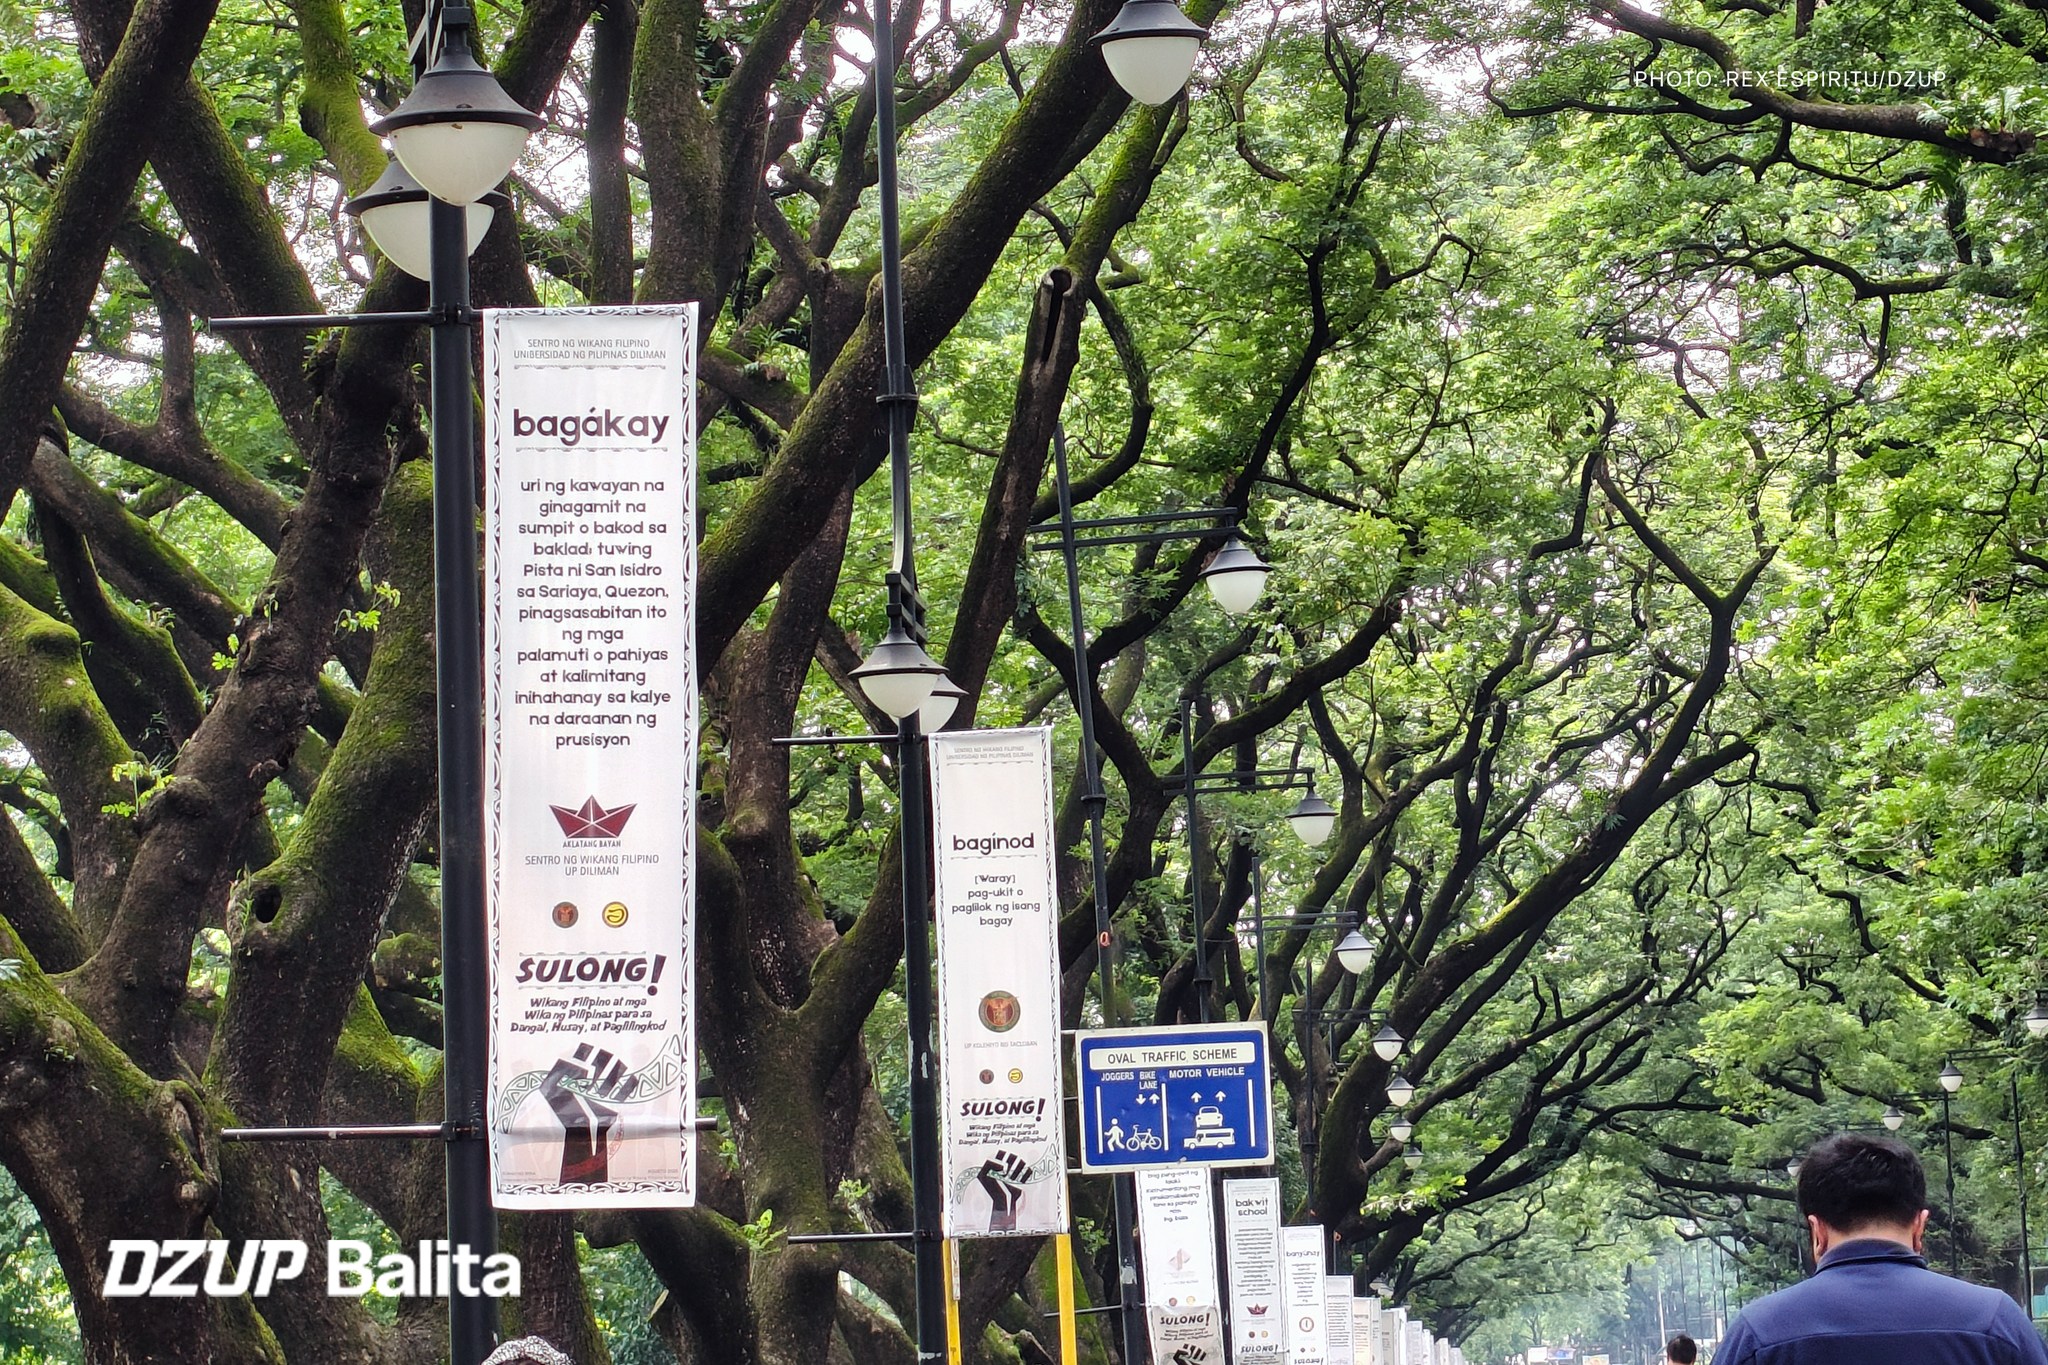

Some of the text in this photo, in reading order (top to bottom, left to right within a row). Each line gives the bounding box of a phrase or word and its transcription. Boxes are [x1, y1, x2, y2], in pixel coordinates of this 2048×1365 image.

[527, 339, 650, 348] SENTRO NG WIKANG FILIPINO
[513, 350, 666, 359] UNIBERSIDAD NG PILIPINAS DILIMAN
[513, 407, 670, 446] bagákay
[521, 479, 664, 496] uri ng kawayan na
[539, 501, 646, 517] ginagamit na
[518, 521, 667, 537] sumpit o bakod sa
[597, 542, 652, 558] tuwing
[523, 563, 662, 577] Pista ni San Isidro
[517, 585, 669, 601] sa Sariaya, Quezon,
[519, 606, 667, 622] pinagsasabitan ito
[562, 629, 624, 643] ng mga
[517, 648, 668, 664] palamuti o pahiyas
[540, 669, 646, 685] at kalimitang
[515, 689, 671, 706] inihahanay sa kalye
[529, 712, 656, 727] na daraanan ng
[556, 733, 630, 749] prusisyon
[563, 840, 621, 848] AKLATANG BAYAN
[525, 855, 659, 865] SENTRO NG WIKANG FILIPINO
[565, 866, 619, 876] UP DILIMAN
[968, 887, 1014, 900] pag-ukit
[951, 902, 1041, 914] paglilok ng isang
[979, 916, 1013, 927] bagay
[515, 954, 667, 996] SULONG!
[530, 997, 647, 1008] Wikang Filipino at mga
[524, 1010, 652, 1022] Wika ng Pilipinas para sa
[510, 1020, 667, 1034] Dangal, Husay, at Paglilingkod
[1107, 1048, 1237, 1064] OVAL TRAFFIC SCHEME
[1101, 1071, 1134, 1081] JOGGERS
[1139, 1071, 1156, 1080] BIKE
[1169, 1067, 1245, 1078] MOTOR VEHICLE
[1139, 1081, 1158, 1090] LANE
[960, 1098, 1046, 1122] SULONG!
[1238, 1207, 1268, 1216] school
[1160, 1313, 1210, 1326] SULONG!
[1240, 1344, 1278, 1355] SULONG!
